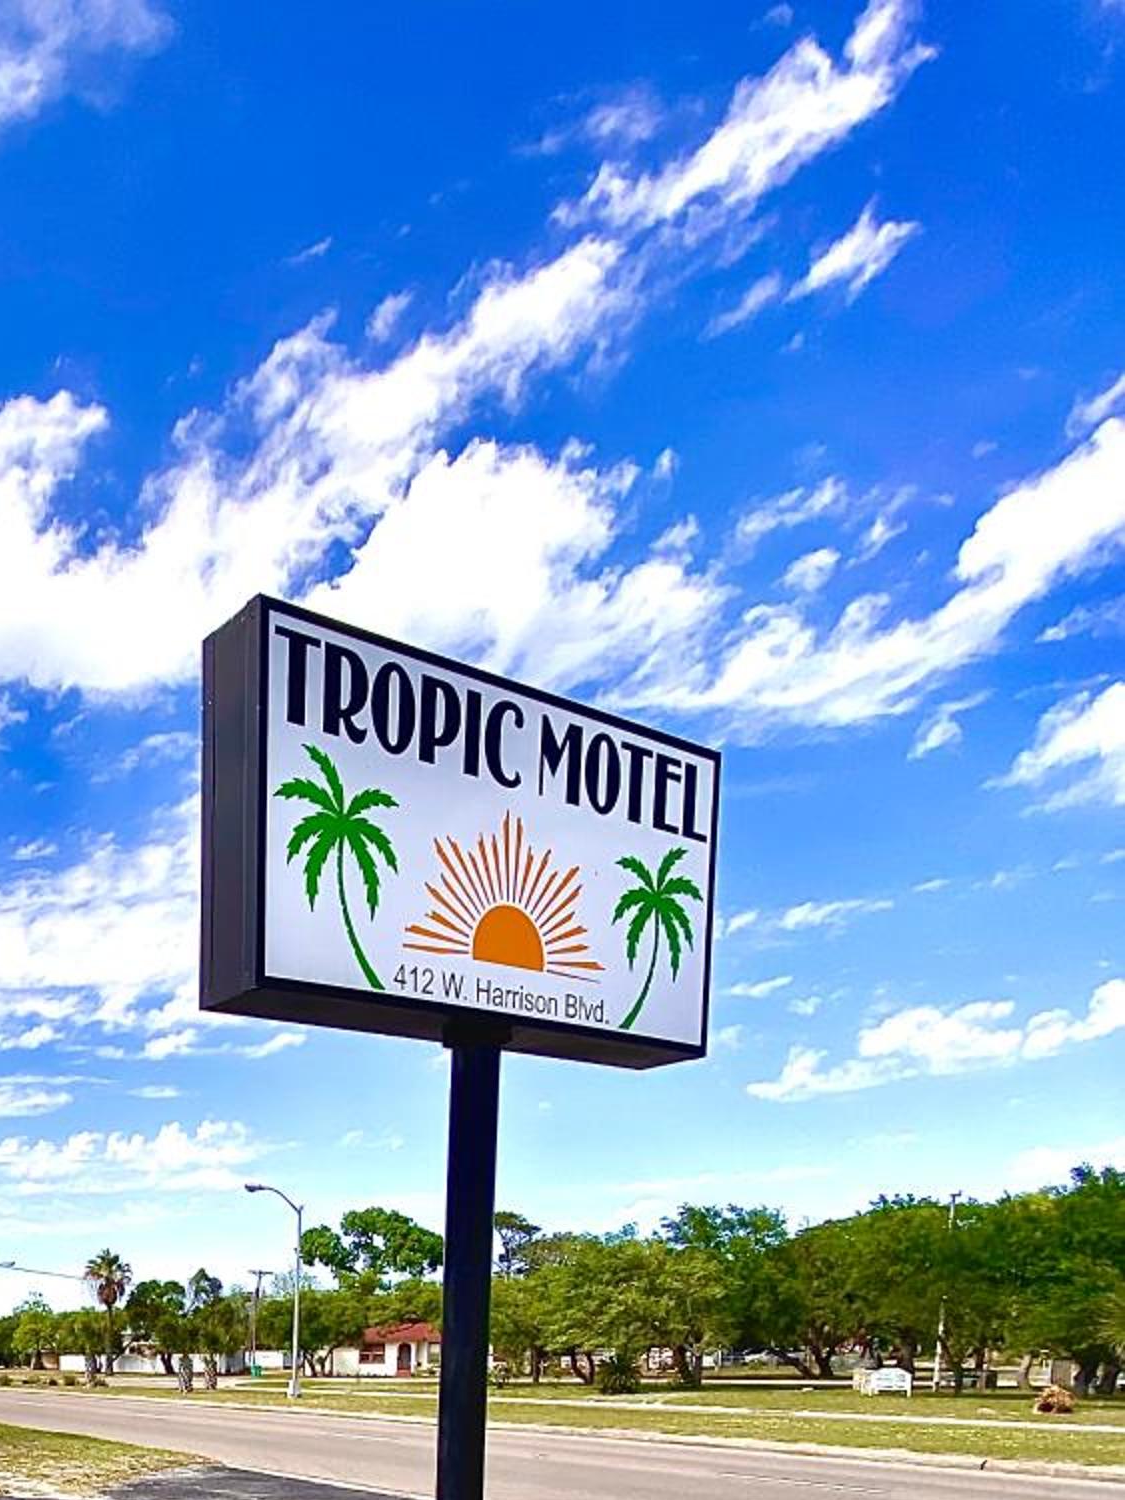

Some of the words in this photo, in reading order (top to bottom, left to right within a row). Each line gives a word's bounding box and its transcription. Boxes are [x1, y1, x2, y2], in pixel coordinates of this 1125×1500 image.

[275, 625, 524, 789] TROPIC
[539, 714, 708, 843] MOTEL
[393, 964, 435, 995] 412
[442, 971, 468, 1000] W.
[476, 978, 558, 1017] Harrison
[565, 993, 610, 1025] Blvd.
